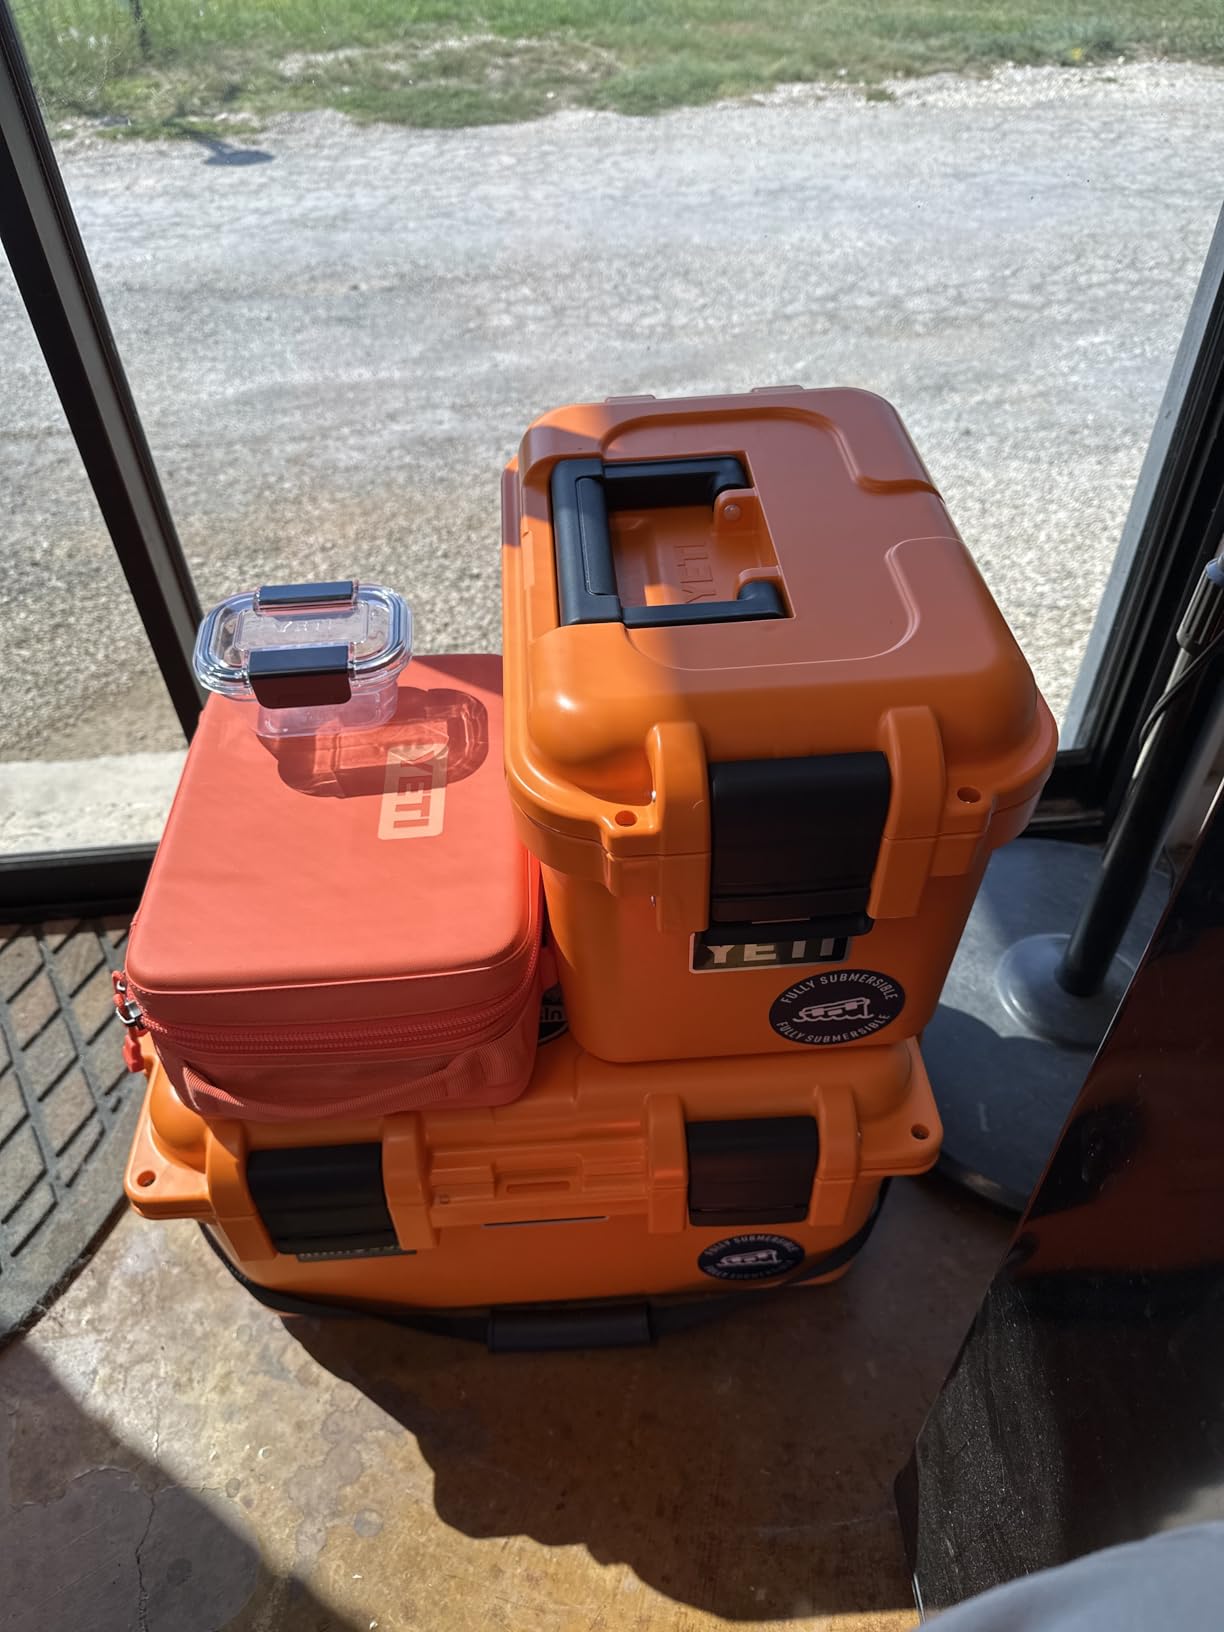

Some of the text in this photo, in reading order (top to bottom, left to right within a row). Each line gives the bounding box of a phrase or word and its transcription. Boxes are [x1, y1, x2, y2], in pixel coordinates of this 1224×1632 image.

[673, 540, 718, 604] YETI
[393, 749, 434, 829] YETI
[780, 972, 898, 1004] FULLY SUBMERSIBLE
[776, 1013, 891, 1043] FULLY SUBMERSIBLE
